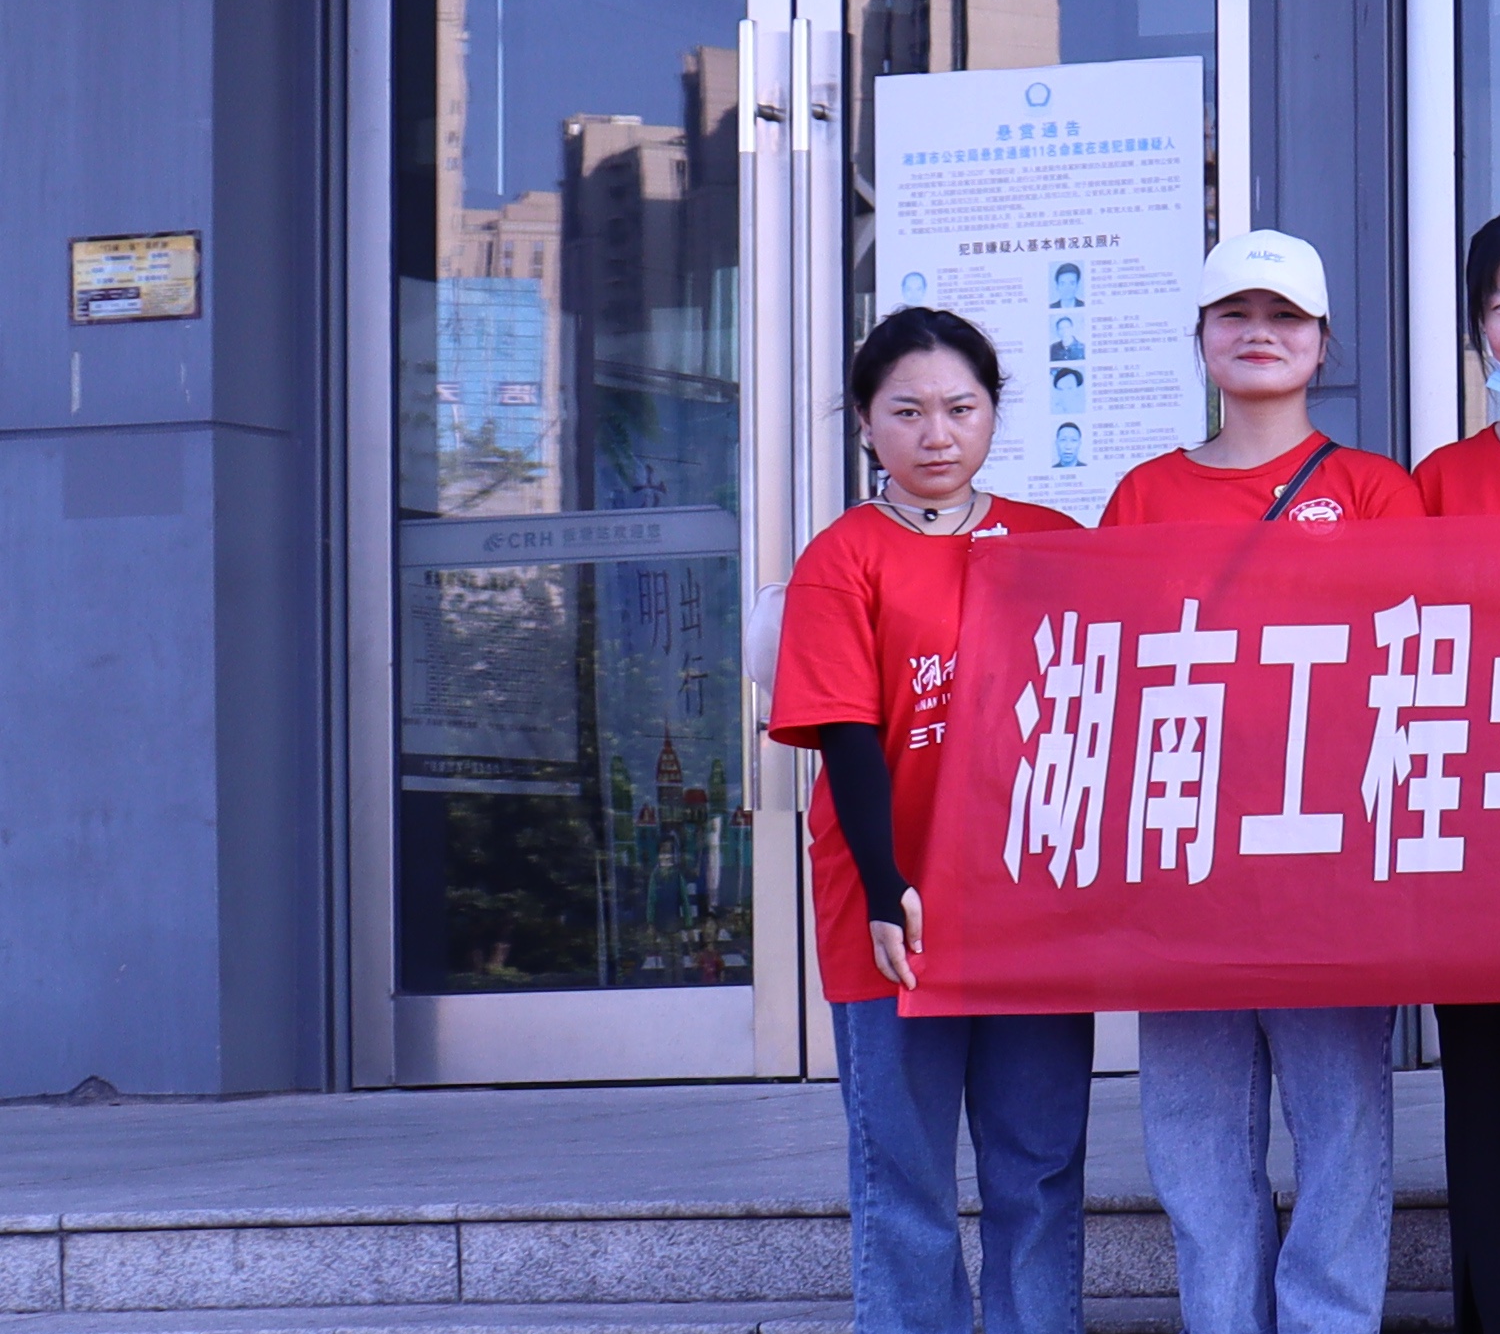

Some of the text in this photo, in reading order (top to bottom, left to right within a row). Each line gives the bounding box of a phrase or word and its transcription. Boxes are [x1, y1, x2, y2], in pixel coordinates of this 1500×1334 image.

[995, 119, 1083, 142] 悬赏通告
[507, 530, 553, 549] CRH
